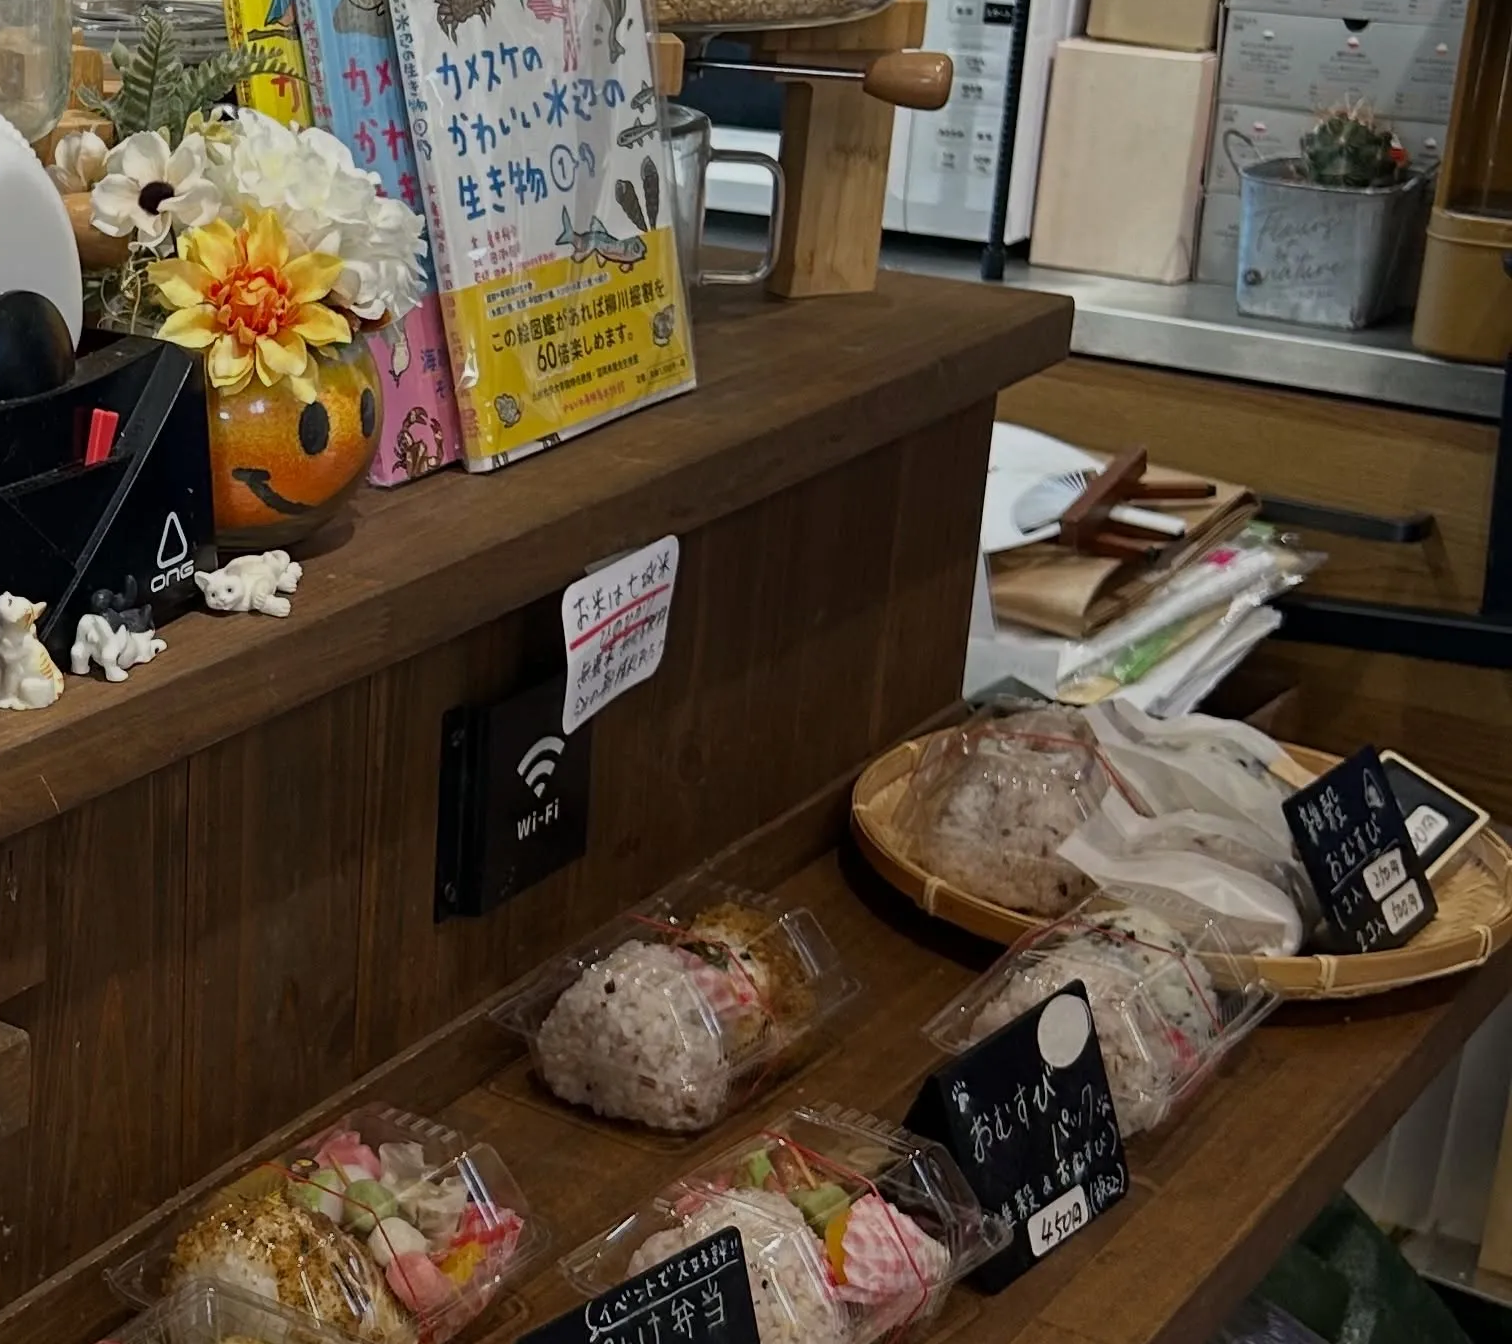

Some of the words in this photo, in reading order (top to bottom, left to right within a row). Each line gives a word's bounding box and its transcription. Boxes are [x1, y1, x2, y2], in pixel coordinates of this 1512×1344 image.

[434, 42, 544, 102] カメスケの
[446, 77, 625, 159] かわいい水辺の
[516, 796, 560, 842] Wi-Fi
[1040, 1202, 1084, 1246] 450円
